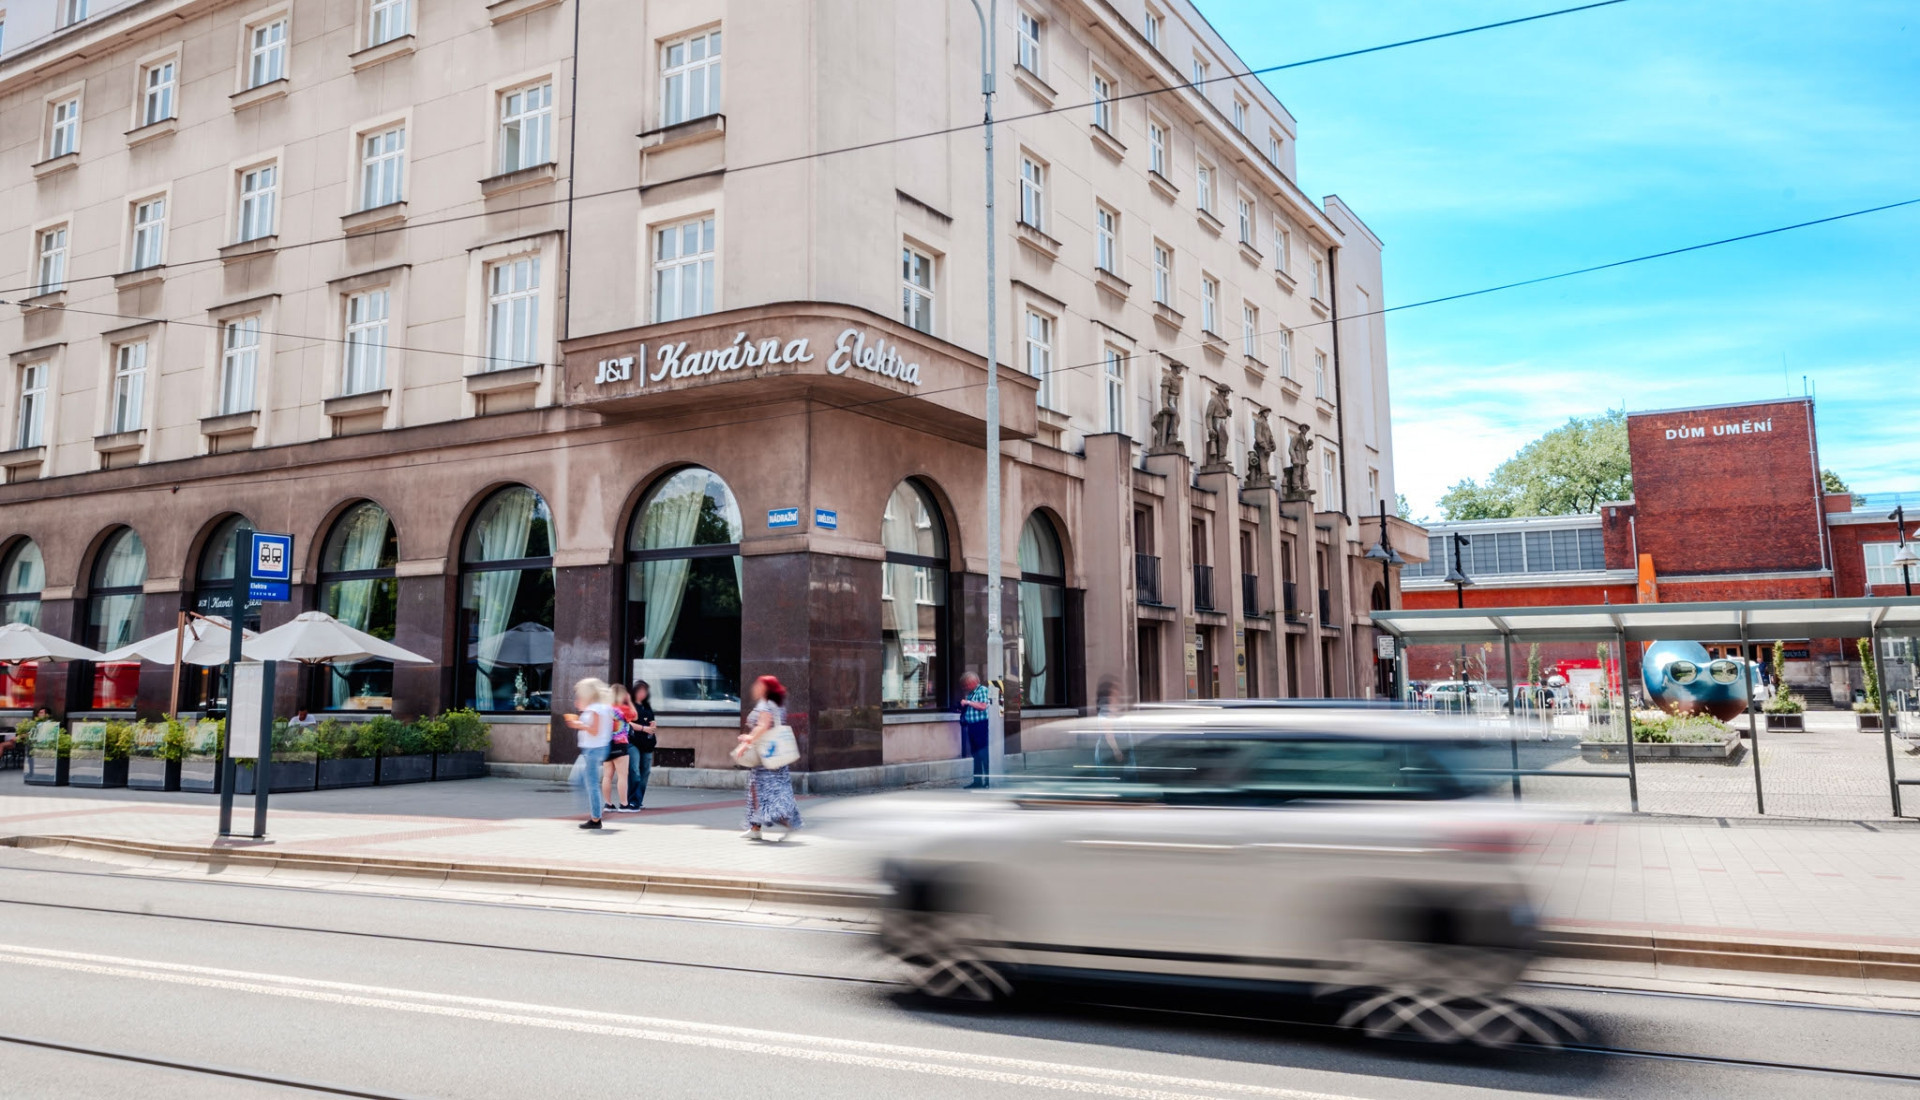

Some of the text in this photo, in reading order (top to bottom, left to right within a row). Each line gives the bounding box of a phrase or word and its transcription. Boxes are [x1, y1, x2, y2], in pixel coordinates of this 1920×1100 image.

[594, 327, 922, 386] J&T Kavárna Elektra
[1665, 417, 1772, 440] DŮM UMĚNÍ
